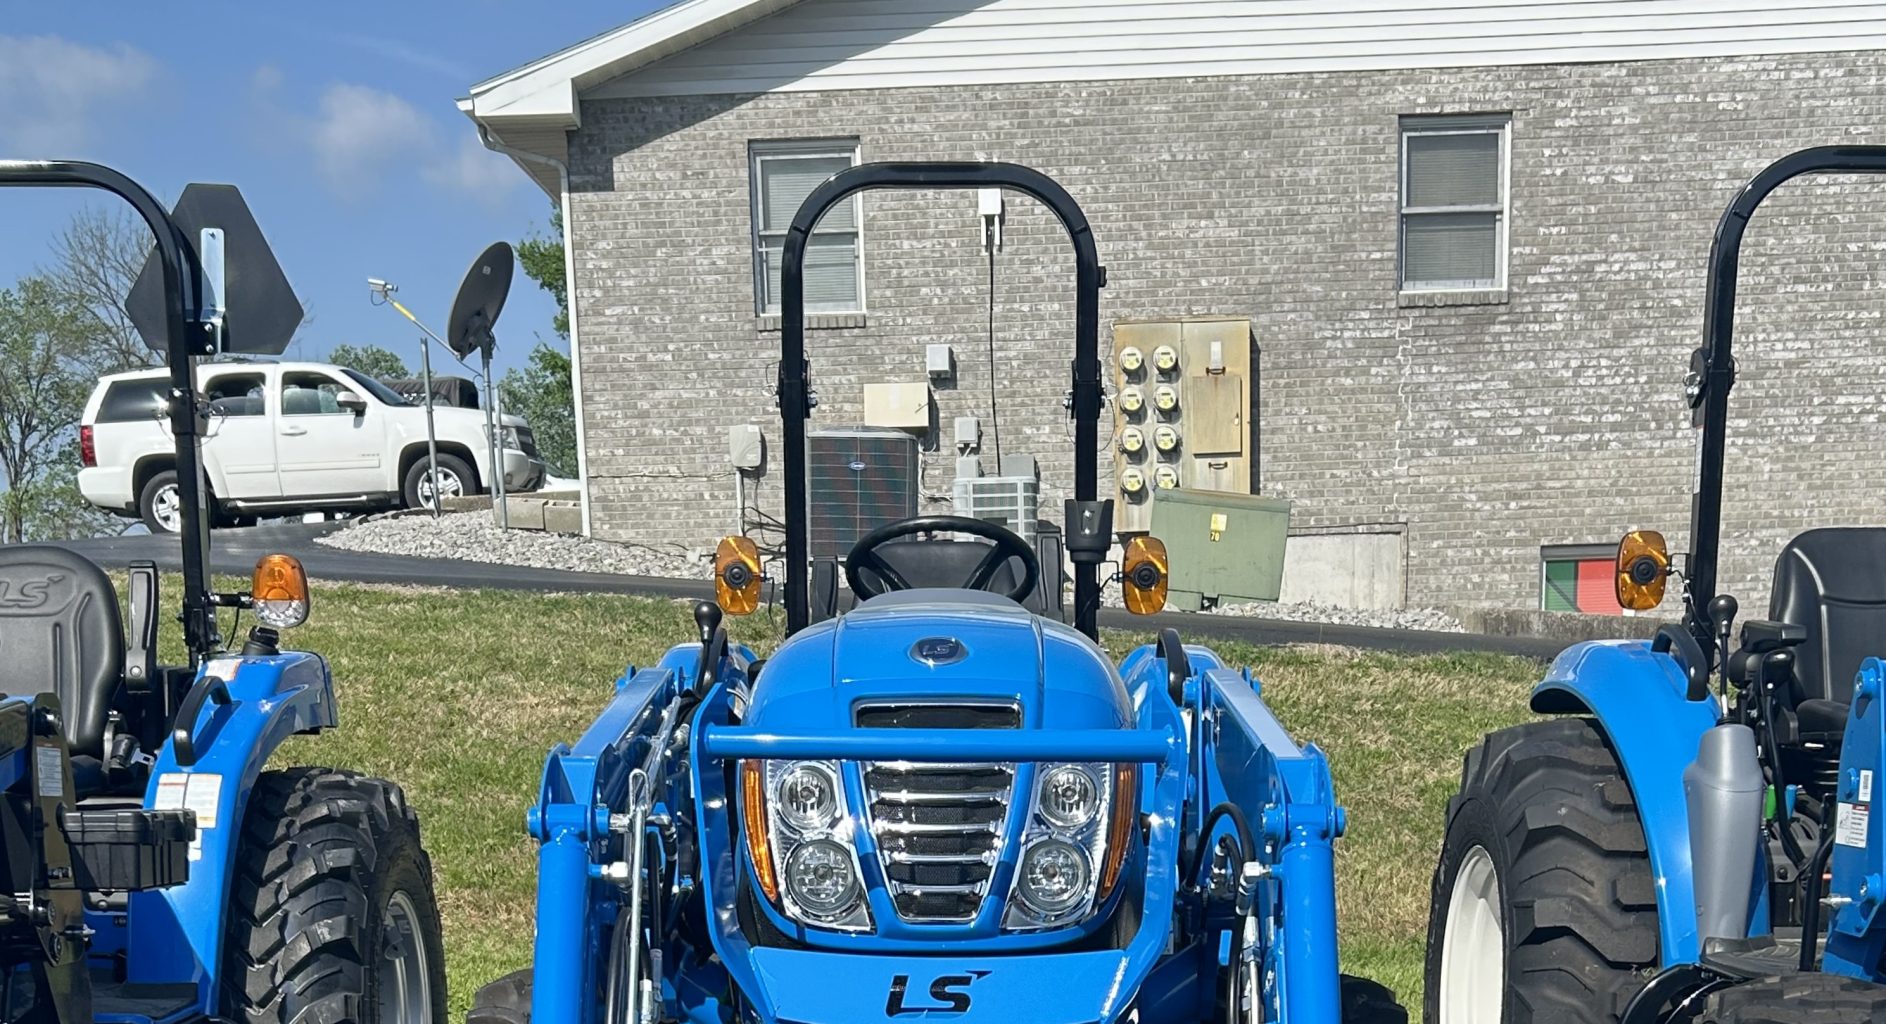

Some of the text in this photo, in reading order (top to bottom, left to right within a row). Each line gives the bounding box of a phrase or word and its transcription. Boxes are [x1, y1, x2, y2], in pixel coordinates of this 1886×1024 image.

[0, 581, 49, 609] LS
[922, 644, 950, 656] LS
[885, 975, 973, 1018] LS
